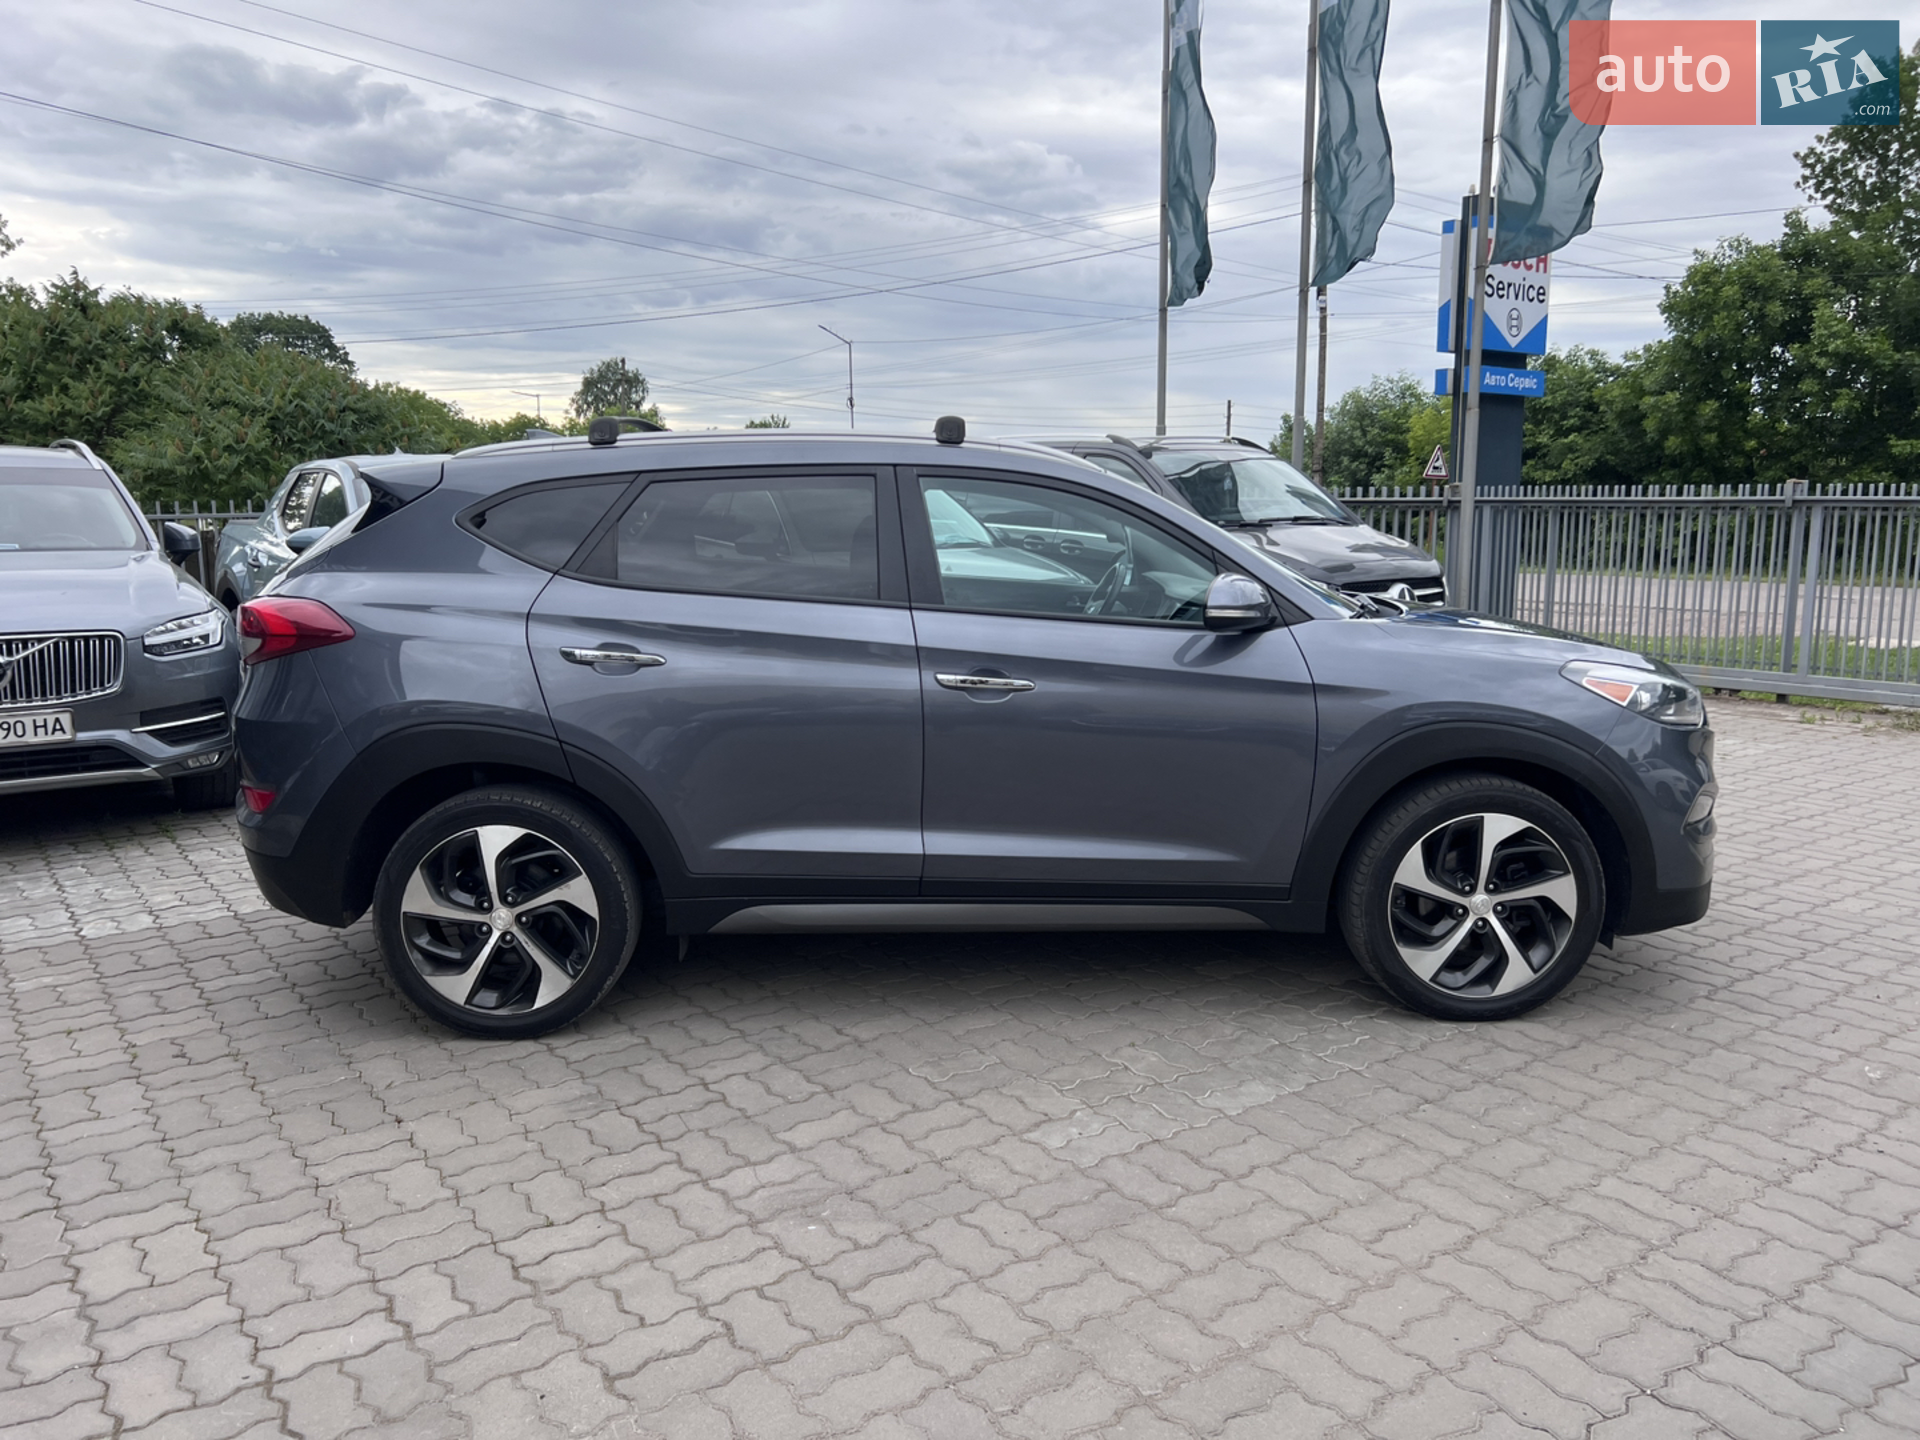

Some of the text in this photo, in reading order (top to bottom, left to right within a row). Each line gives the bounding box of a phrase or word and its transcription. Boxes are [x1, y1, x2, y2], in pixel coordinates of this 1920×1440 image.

[1484, 273, 1546, 304] Service
[1484, 371, 1537, 391] Авто Сервіс
[33, 716, 67, 737] HA
